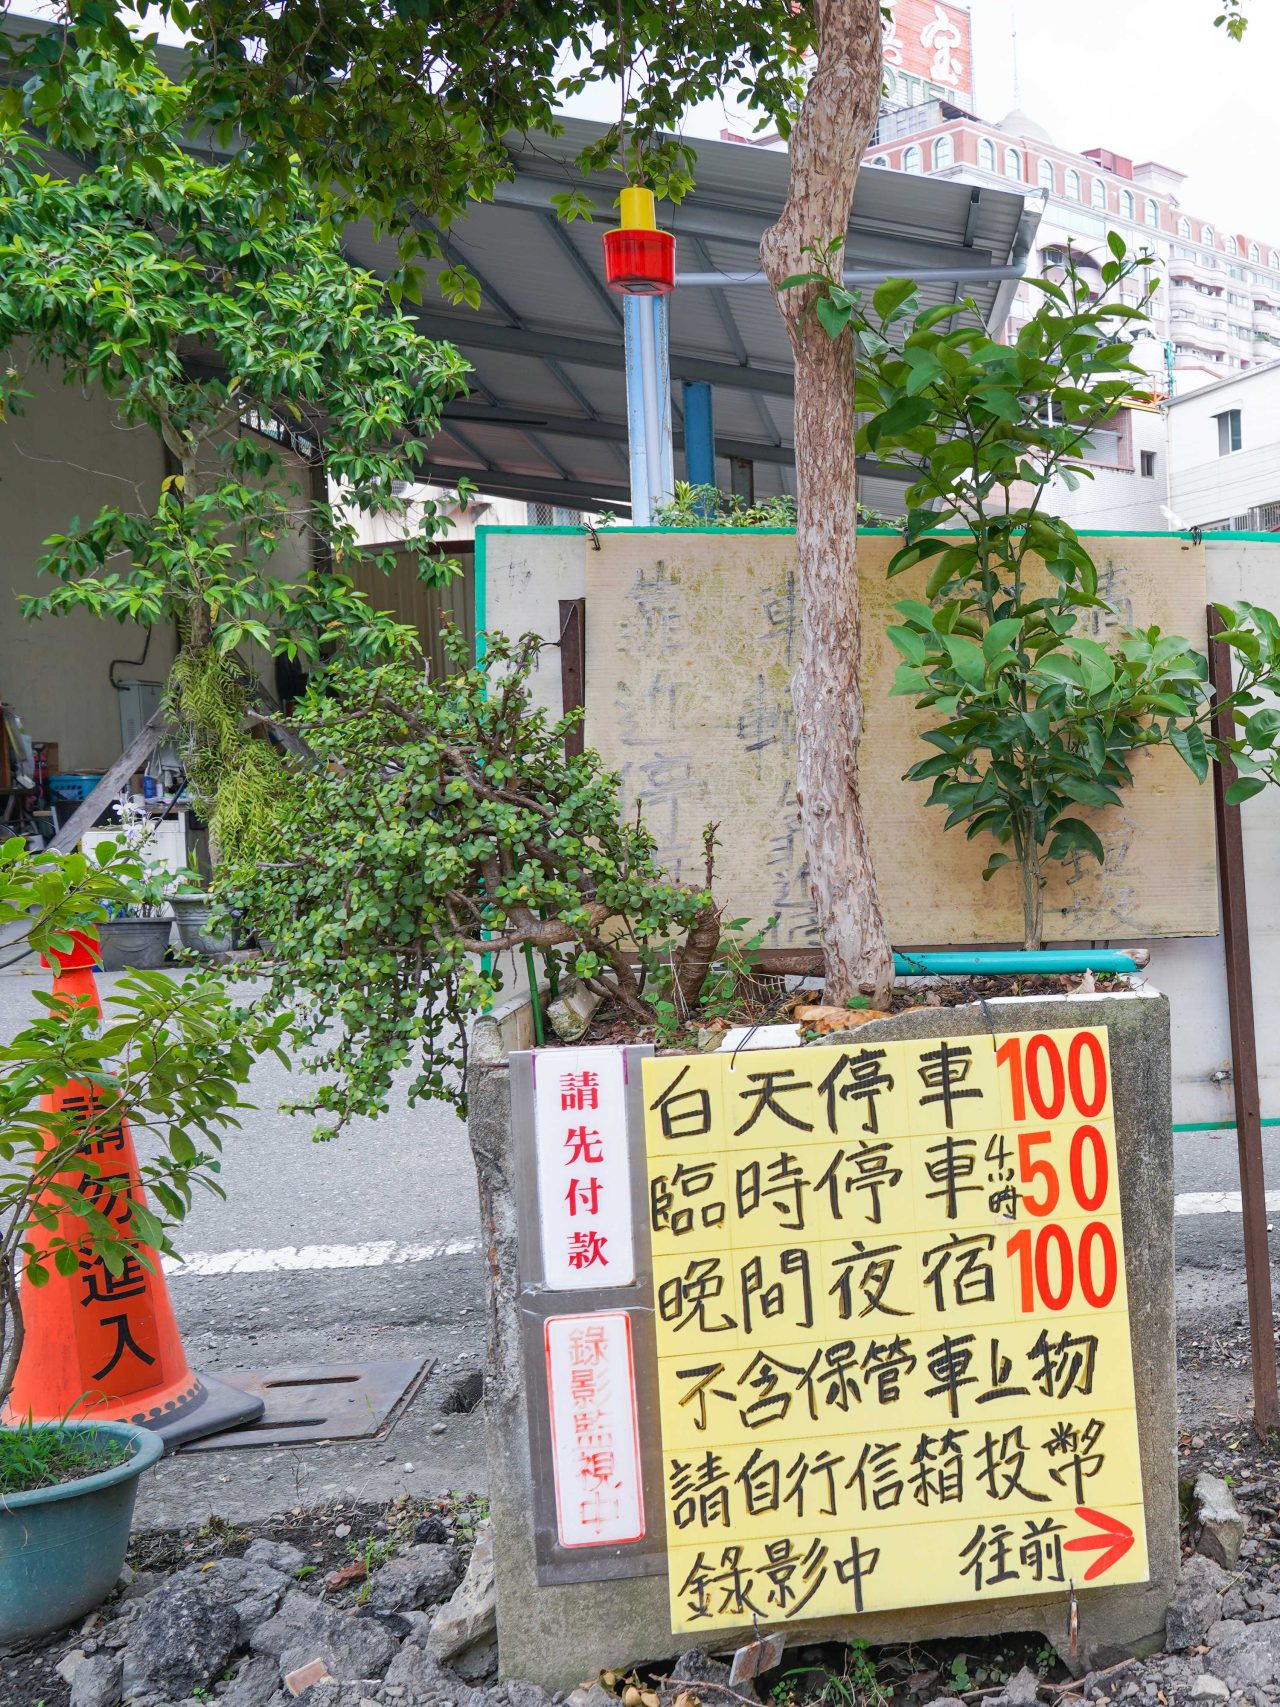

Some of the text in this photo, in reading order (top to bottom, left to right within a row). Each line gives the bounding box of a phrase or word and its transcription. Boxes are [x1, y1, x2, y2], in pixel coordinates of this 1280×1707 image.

[650, 1031, 1107, 1139] 白天停車 100
[559, 1071, 610, 1271] 請先付款
[651, 1136, 984, 1237] 臨時停車
[1018, 1125, 1109, 1217] 50
[658, 1221, 1118, 1334] 晚間夜宿 100
[676, 1329, 1099, 1431] 不含保管車上物
[670, 1418, 1106, 1530] 請自行信箱投幣
[677, 1517, 1068, 1622] 錄影中 往前
